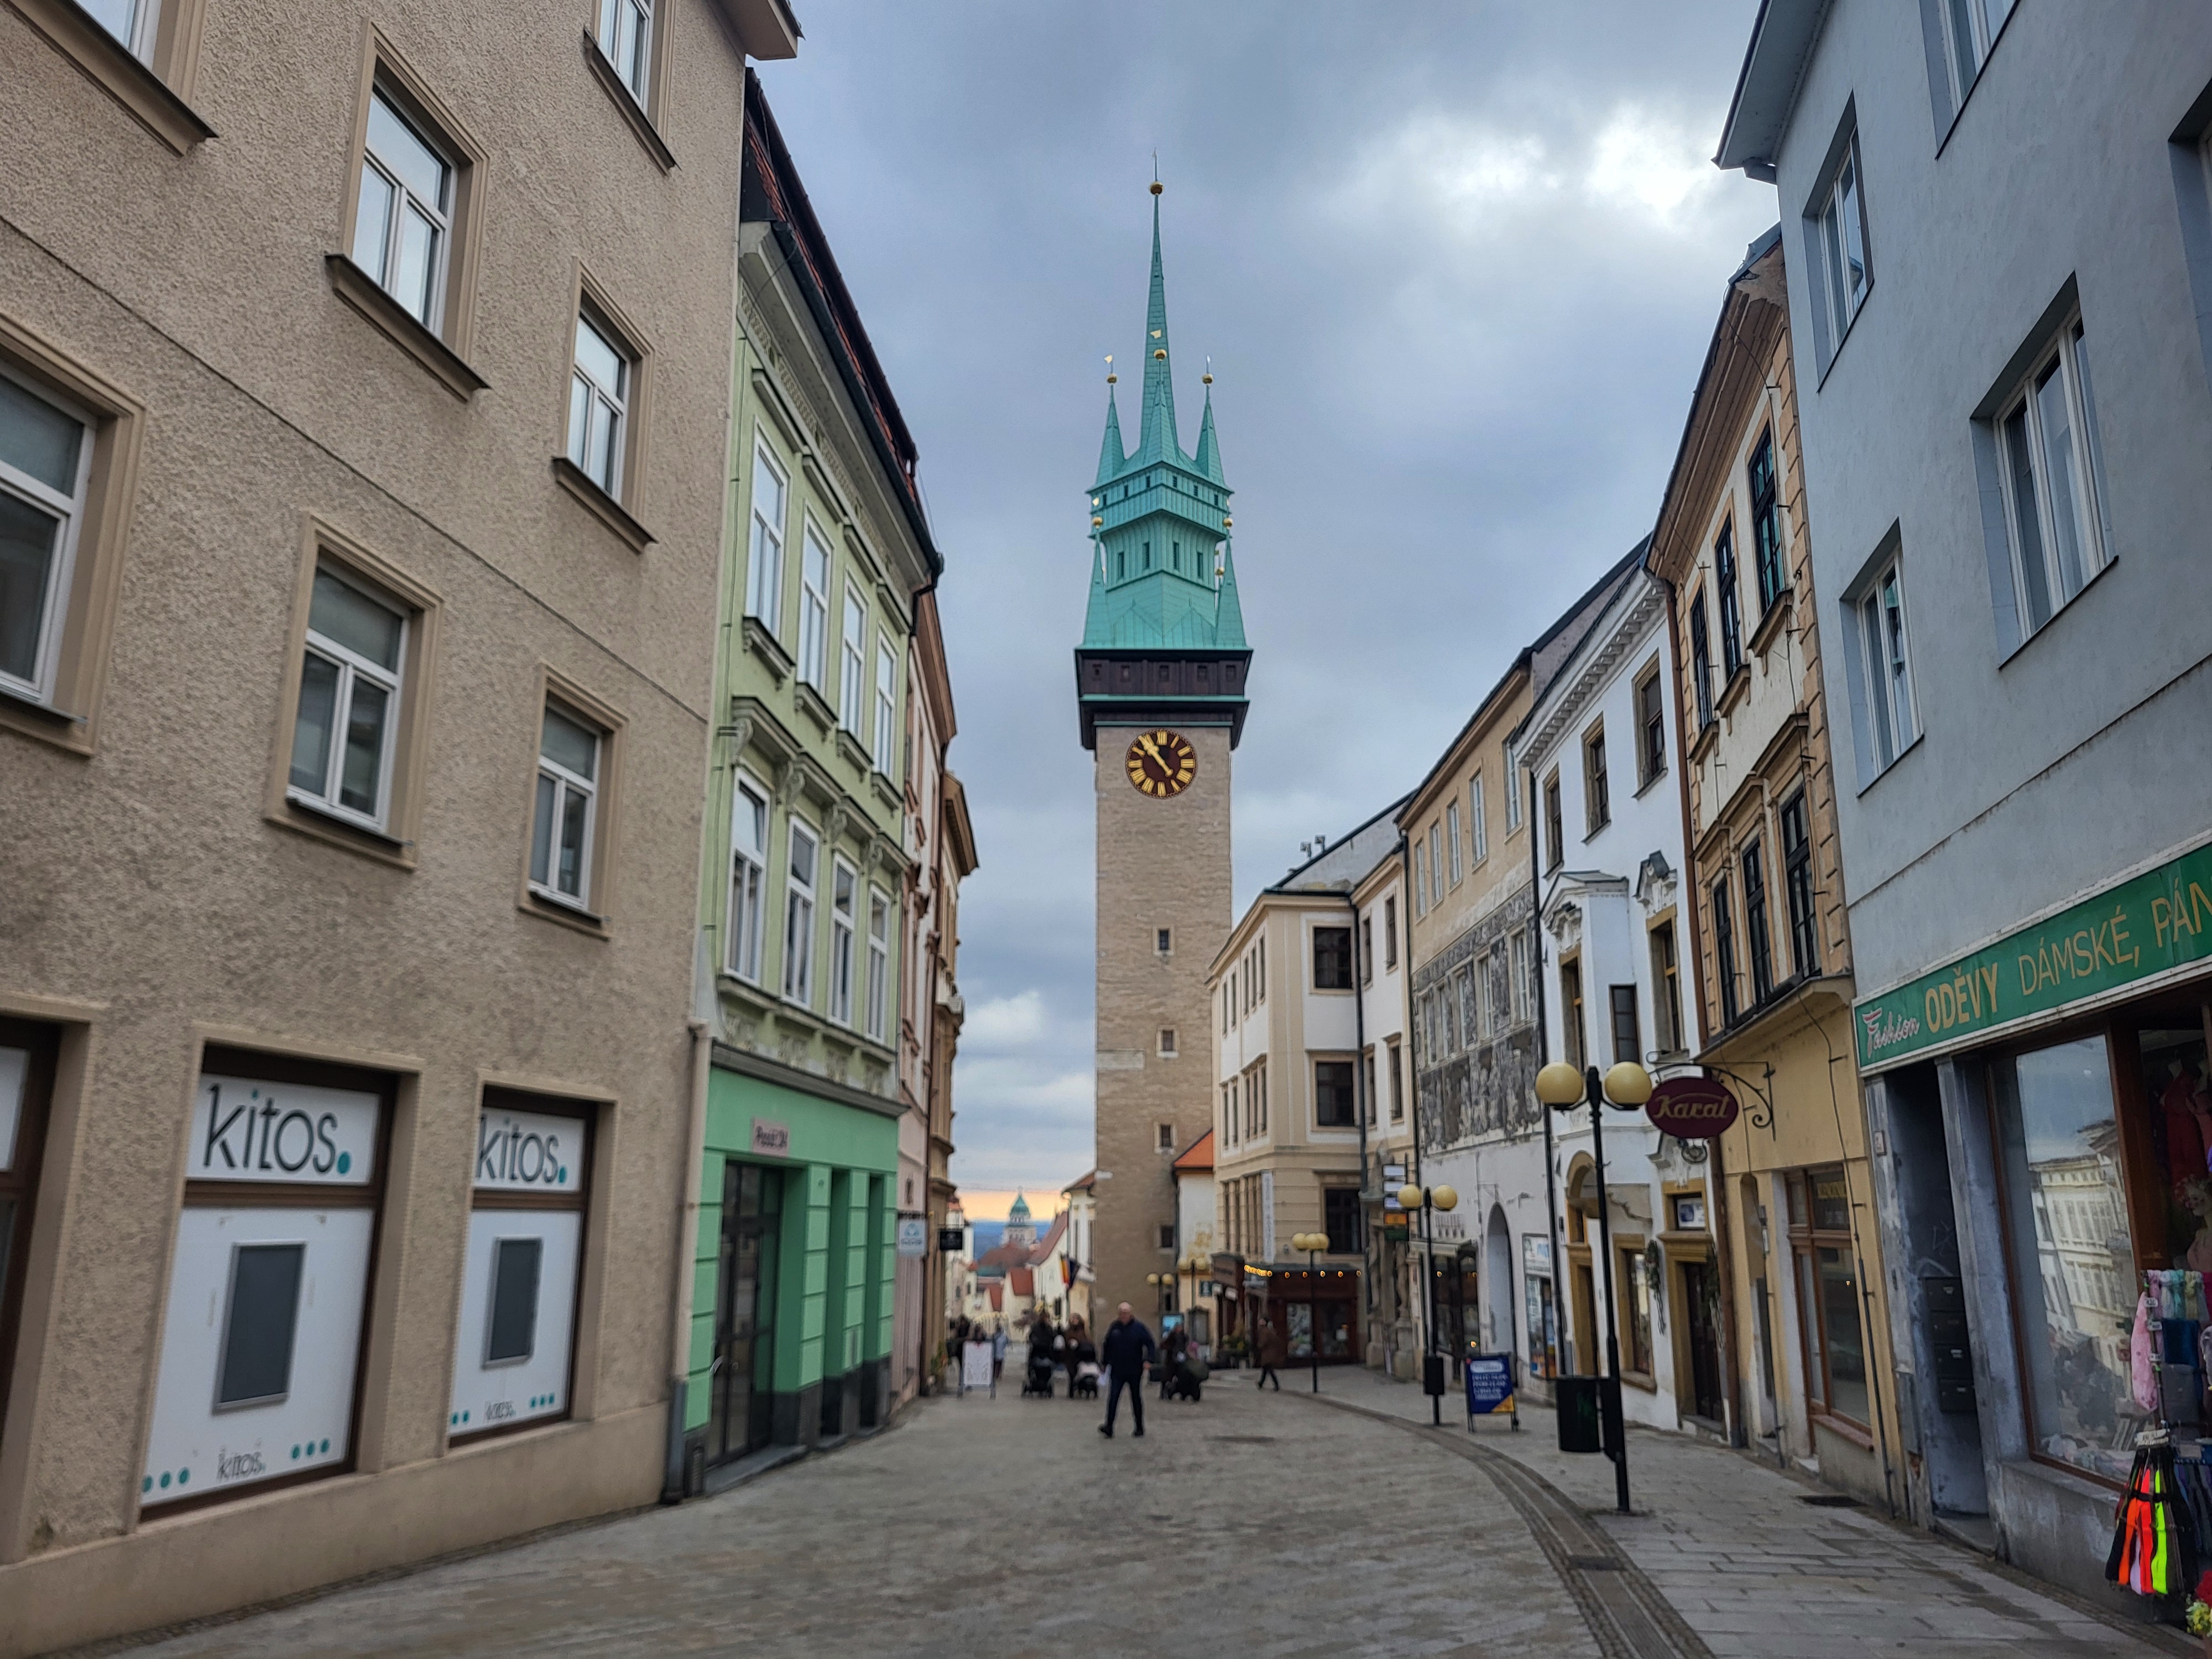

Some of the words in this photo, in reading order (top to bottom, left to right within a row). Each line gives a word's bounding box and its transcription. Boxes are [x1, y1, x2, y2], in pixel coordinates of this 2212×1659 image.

[1861, 1006, 1920, 1058] Fashion
[1925, 962, 1998, 1033] ODĚVY
[2018, 905, 2140, 996] DÁMSKÉ,
